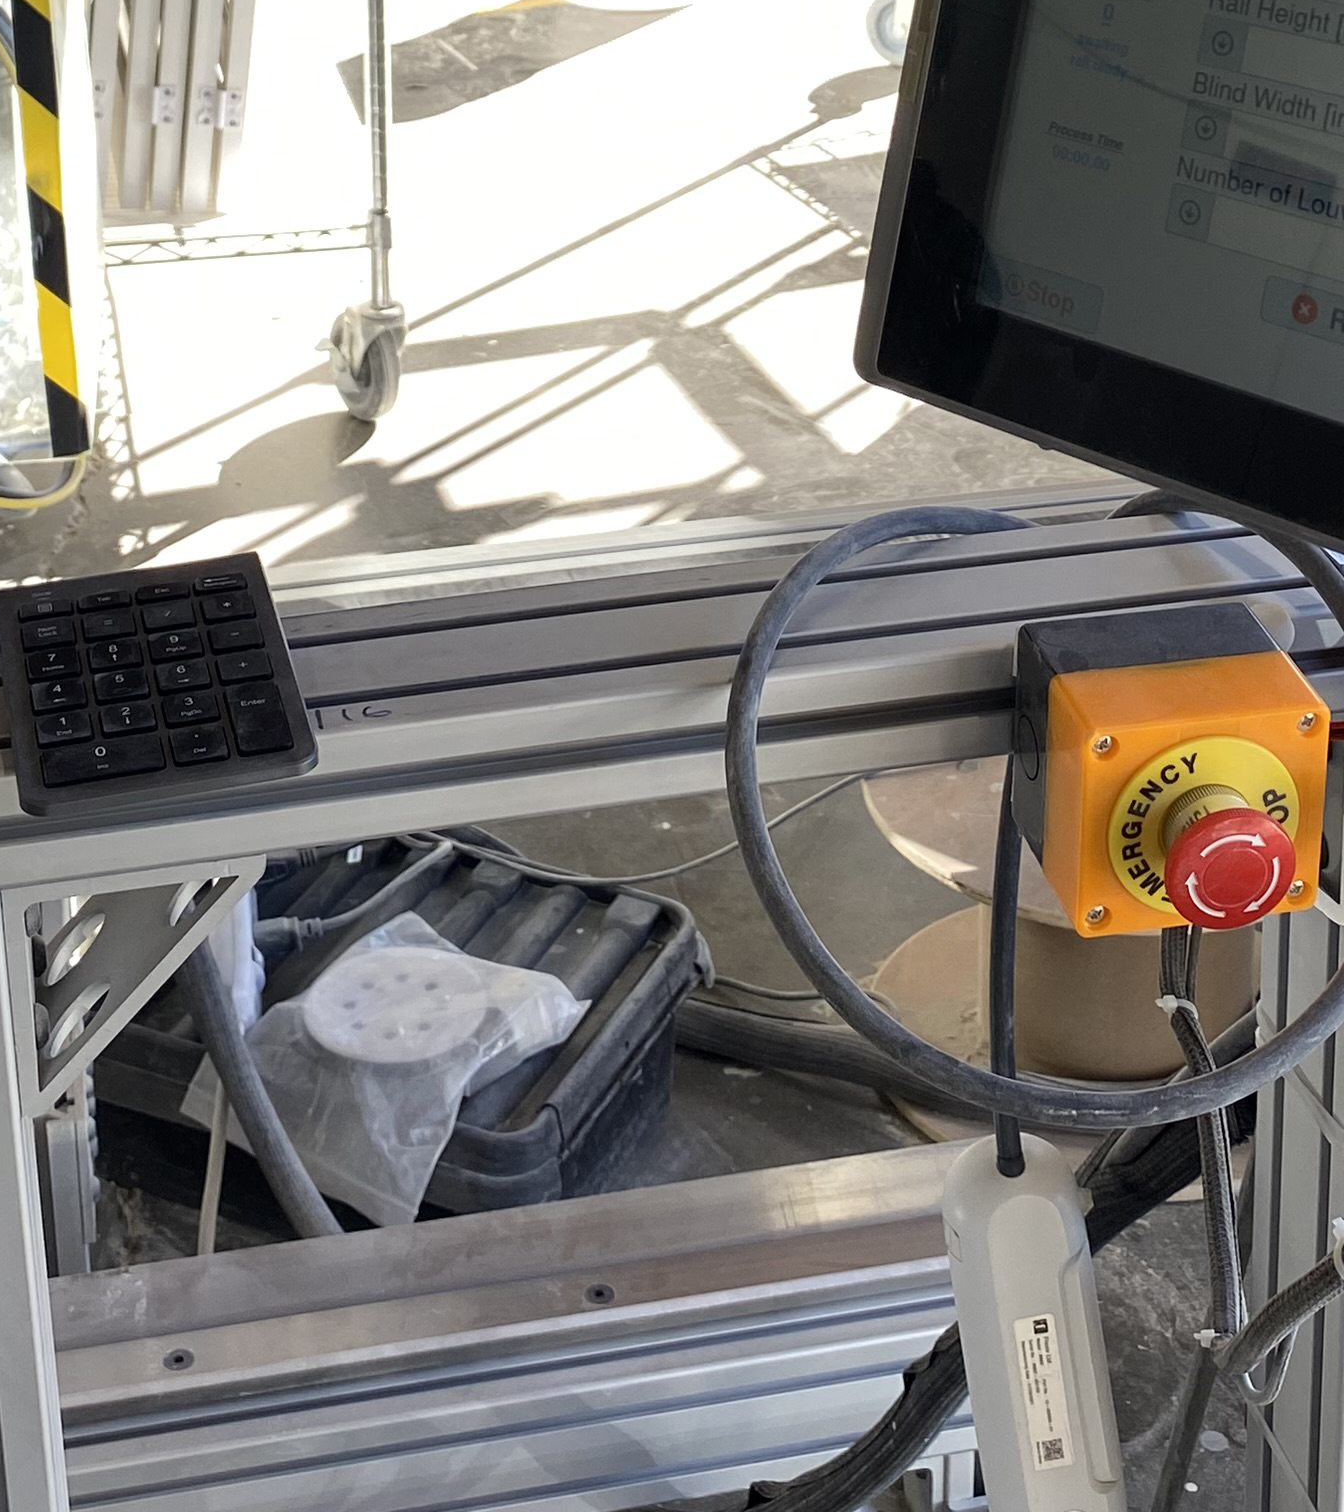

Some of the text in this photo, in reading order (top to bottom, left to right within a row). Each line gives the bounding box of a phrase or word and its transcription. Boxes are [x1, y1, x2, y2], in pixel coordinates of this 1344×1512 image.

[1103, 2, 1115, 22] 0
[1192, 70, 1248, 104] Blind
[1254, 84, 1317, 123] Width
[1048, 120, 1094, 143] Process
[1176, 155, 1264, 195] Number
[1268, 181, 1292, 204] of
[1026, 280, 1076, 320] Stop
[169, 634, 179, 644] 9
[108, 643, 118, 653] 8
[46, 652, 56, 662] 7
[176, 664, 186, 674] 6
[114, 673, 125, 683] 5
[52, 683, 62, 693] 4
[183, 696, 194, 706] 3
[239, 697, 266, 707] Enter
[120, 706, 131, 716] 2
[58, 716, 67, 726] 1
[94, 745, 106, 757] 0
[1261, 787, 1290, 826] OP
